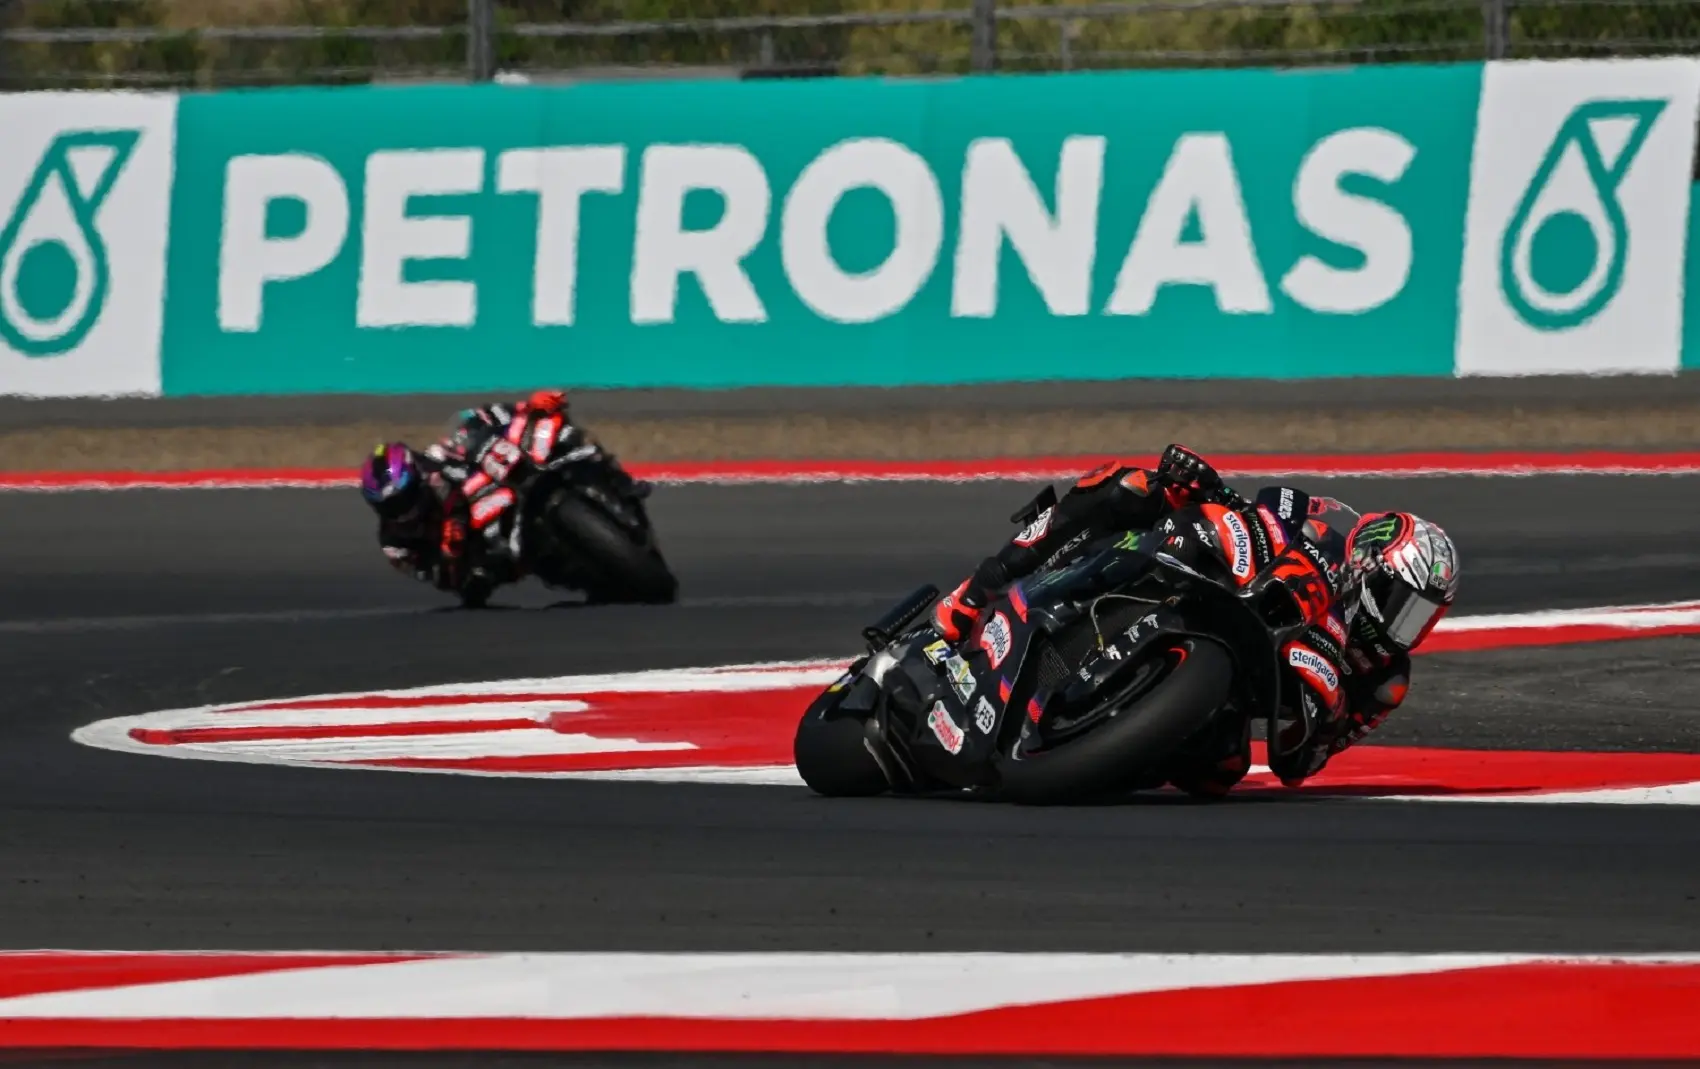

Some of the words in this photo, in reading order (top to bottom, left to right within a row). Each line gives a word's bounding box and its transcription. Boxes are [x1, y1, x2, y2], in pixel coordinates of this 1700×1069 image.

[218, 126, 1416, 332] PETRONAS
[1225, 513, 1250, 574] sterilgarda
[1303, 541, 1339, 596] TARGA
[1291, 650, 1337, 687] sterilgarda
